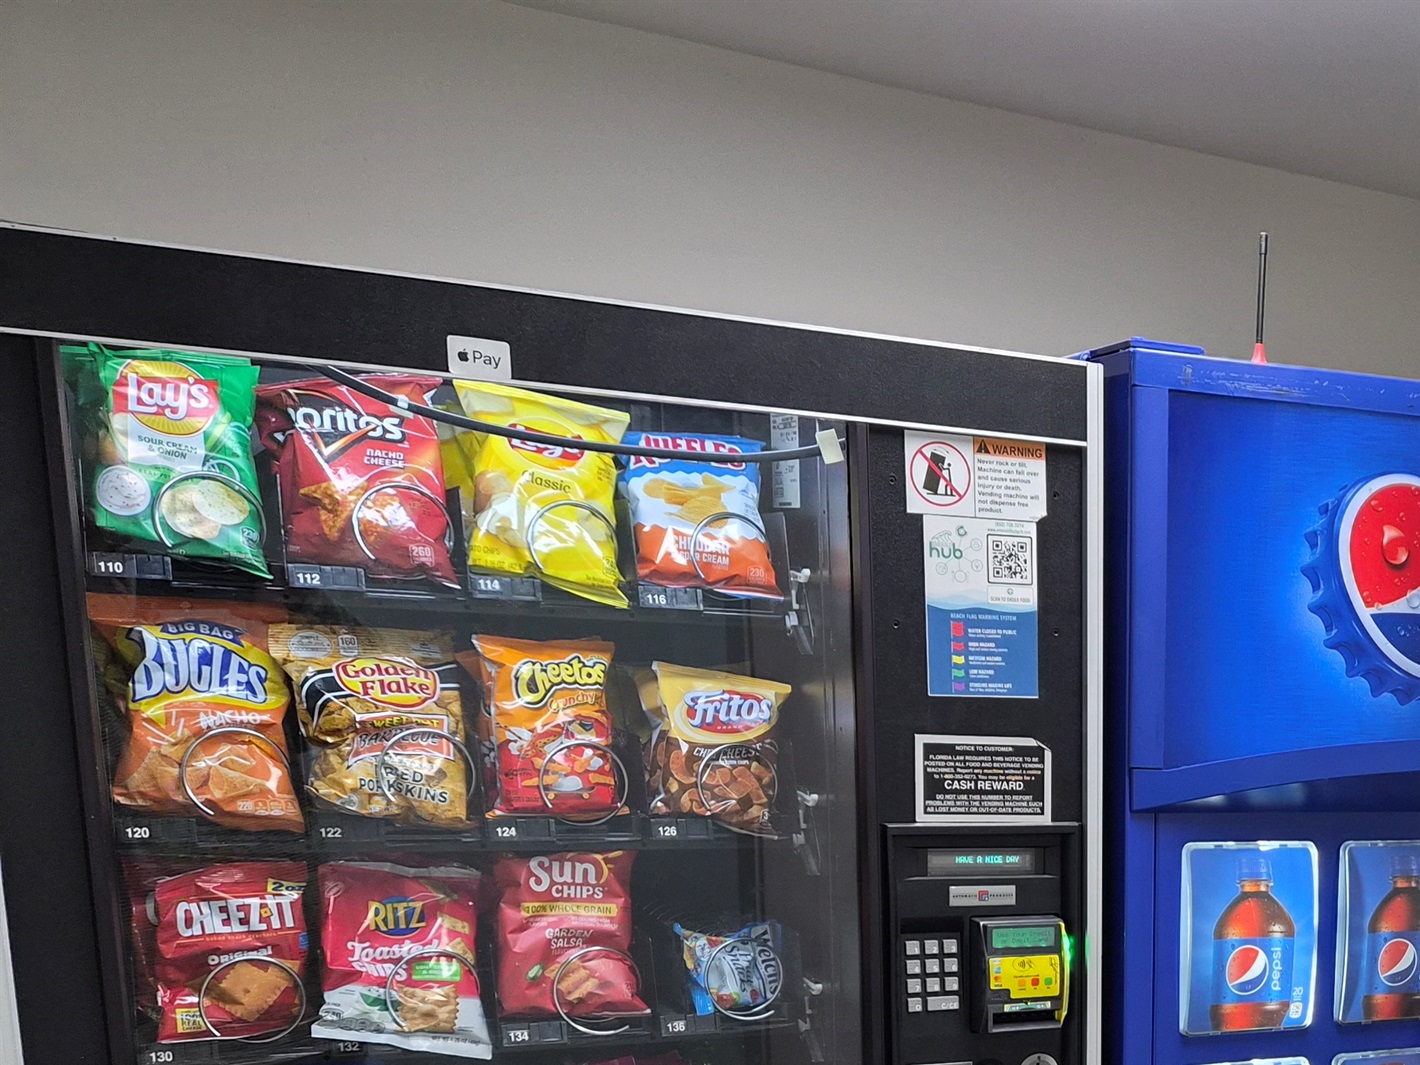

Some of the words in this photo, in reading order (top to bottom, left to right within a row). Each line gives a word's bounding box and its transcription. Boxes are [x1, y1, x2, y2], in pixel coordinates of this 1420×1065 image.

[472, 352, 501, 370] Pay
[127, 373, 210, 420] Lay's
[138, 435, 163, 446] SOUR
[158, 448, 187, 460] ONION
[366, 449, 404, 460] NACHO
[992, 444, 1042, 458] WARNING
[364, 457, 405, 469] CHEESE
[522, 470, 571, 495] Classic
[978, 490, 1002, 498] Vending
[412, 547, 431, 557] 260
[929, 541, 963, 559] hub
[702, 553, 730, 565] CREAM
[98, 561, 123, 573] 110
[750, 568, 764, 577] 230
[296, 573, 320, 584] 112
[478, 579, 500, 589] 114
[647, 594, 666, 604] 116
[168, 622, 197, 633] BIG
[200, 624, 234, 640] BAG
[128, 625, 267, 704] BUGLES
[341, 663, 431, 680] Golden
[516, 656, 605, 705] Cheetos
[359, 677, 431, 697] Flake
[548, 691, 596, 712] Crunchy
[684, 689, 772, 727] Fritos
[944, 780, 975, 790] CASH
[125, 827, 149, 839] 120
[320, 827, 341, 838] 122
[496, 827, 516, 837] 124
[658, 826, 677, 836] 126
[529, 856, 597, 892] Sun
[551, 885, 603, 899] CHIPS
[550, 904, 580, 912] WHOLE
[584, 905, 612, 914] GRAIN
[368, 900, 426, 931] RITZ
[545, 928, 593, 939] GARDEN
[551, 938, 583, 949] SALSA
[347, 939, 441, 962] Toasted
[1271, 947, 1282, 991] pepsi
[1293, 987, 1304, 996] 20
[667, 1021, 685, 1032] 136
[509, 1031, 529, 1042] 134
[338, 1043, 359, 1051] 132
[150, 1052, 173, 1063] 130
